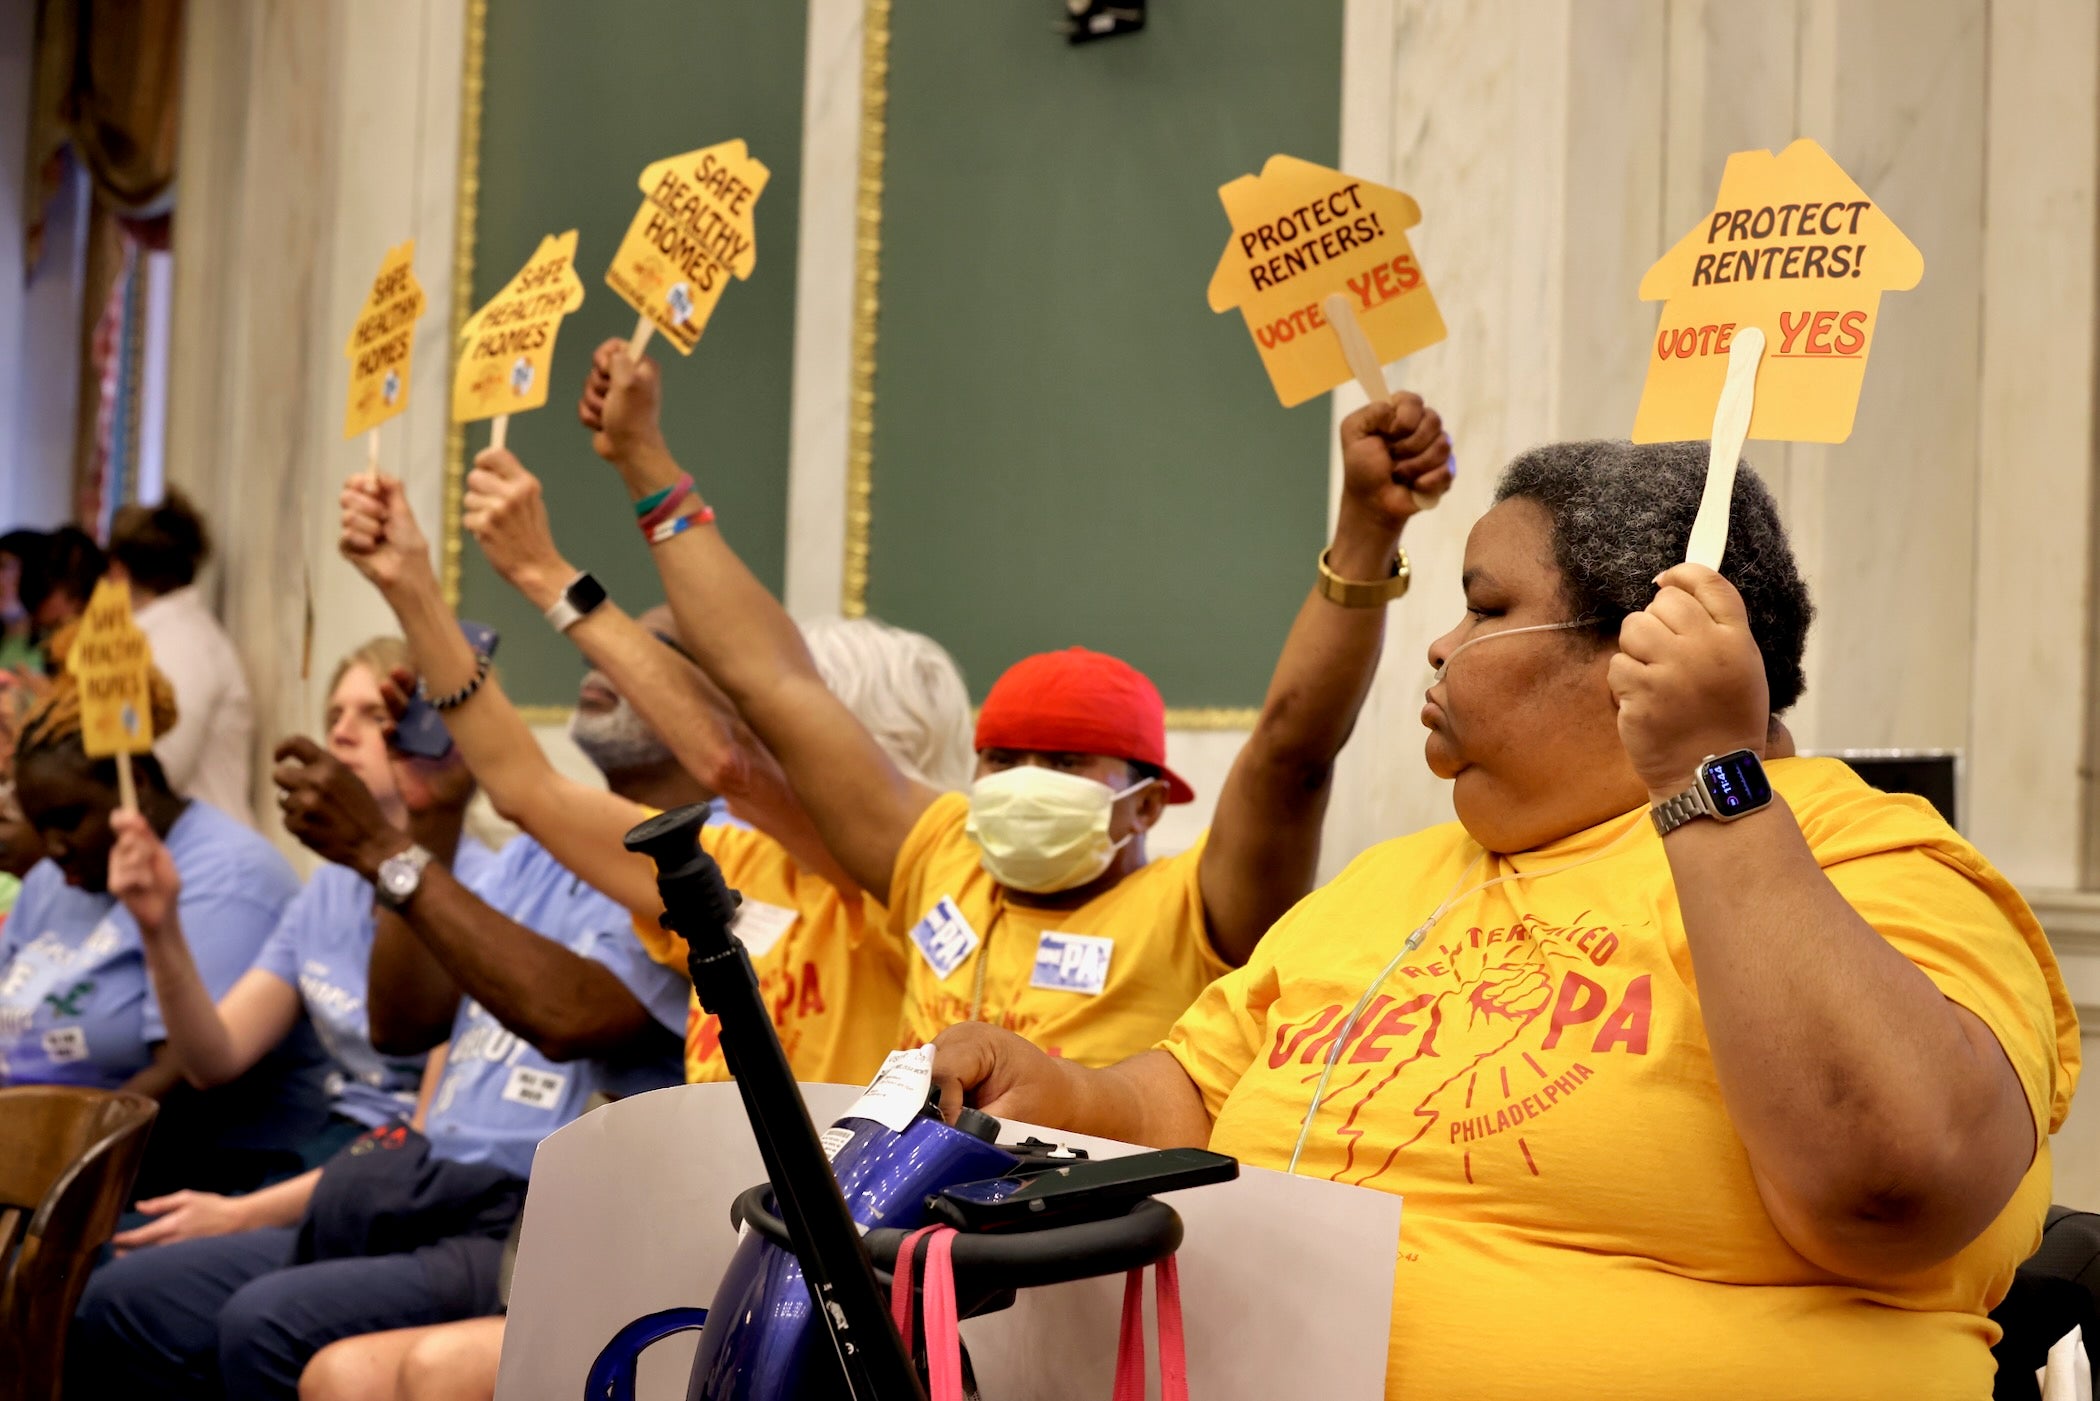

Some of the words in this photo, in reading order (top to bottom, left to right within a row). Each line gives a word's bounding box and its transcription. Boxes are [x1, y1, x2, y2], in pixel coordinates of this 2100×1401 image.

[694, 153, 753, 217] SAFE
[653, 170, 750, 265] HEALTHY
[1240, 184, 1363, 259] PROTECT
[1707, 201, 1871, 244] PROTECT
[515, 255, 569, 295] SAFE
[644, 212, 720, 293] HOMES
[1249, 212, 1386, 293] RENTERS!
[1692, 245, 1867, 287] RENTERS!
[373, 262, 410, 307] SAFE
[1255, 303, 1327, 350] VOTE
[1346, 254, 1424, 313] YES
[355, 330, 411, 381] HOMES
[472, 320, 550, 361] HOMES
[1657, 323, 1736, 361] VOTE
[1771, 310, 1867, 358] YES
[1714, 765, 1732, 794] 11:44
[1268, 994, 1437, 1070] ONE
[1540, 970, 1653, 1056] PA
[1450, 1061, 1596, 1145] PHILADELPHIA
